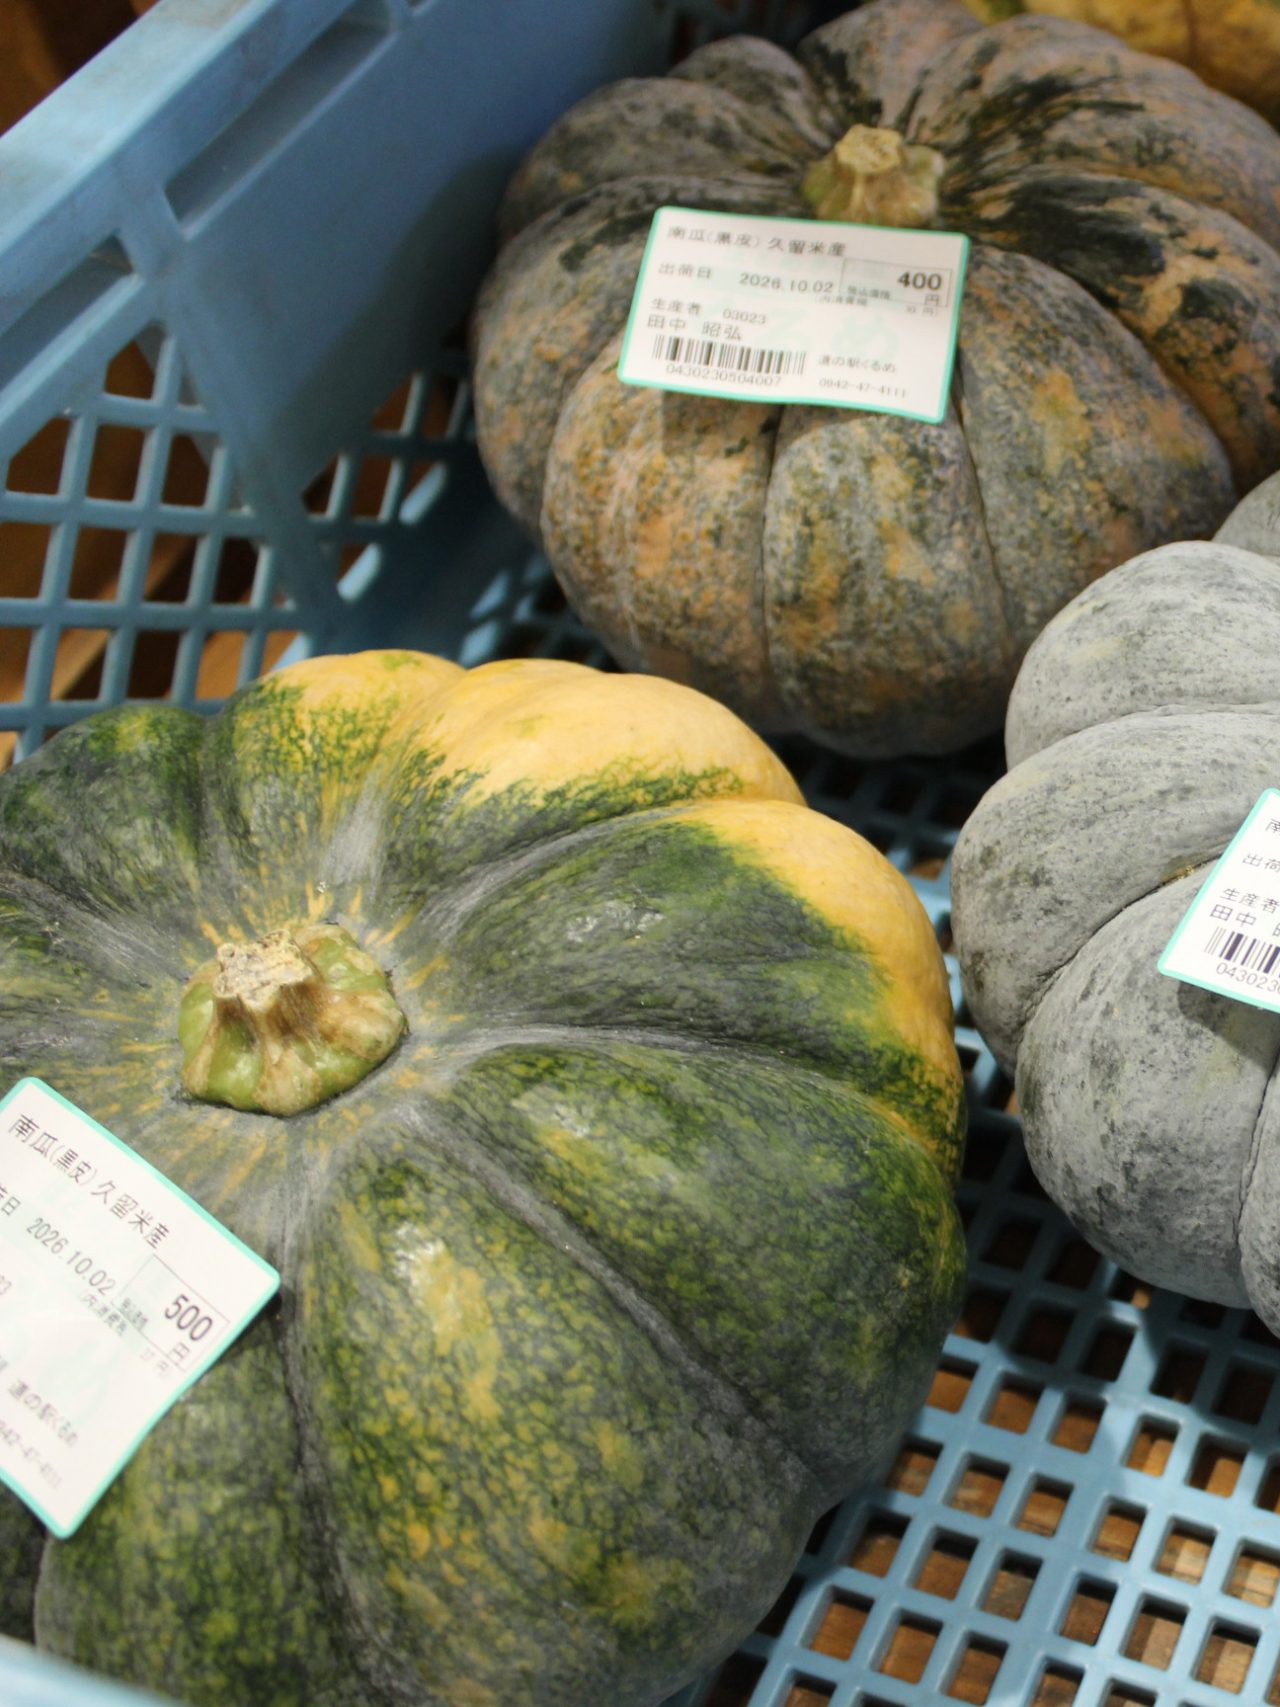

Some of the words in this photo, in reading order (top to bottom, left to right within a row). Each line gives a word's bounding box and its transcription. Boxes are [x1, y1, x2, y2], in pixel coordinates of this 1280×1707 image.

[668, 226, 760, 249] 南瓜(黒皮)
[767, 237, 846, 257] 久留米産
[658, 261, 713, 280] 出荷日
[738, 273, 834, 293] 2026.10.02
[896, 271, 943, 291] 400
[650, 297, 702, 316] 生産者
[722, 308, 767, 326] 03023
[924, 294, 941, 307] 円
[646, 314, 688, 332] 田中
[701, 321, 743, 342] 昭弘
[665, 363, 783, 388] 0430230504007
[1208, 903, 1258, 930] 田中
[7, 1111, 99, 1188] 南瓜(黒皮)
[89, 1178, 172, 1251] 久留米産
[25, 1215, 118, 1298] 2026.10.02
[162, 1292, 214, 1343] 500
[166, 1341, 191, 1367] 円
